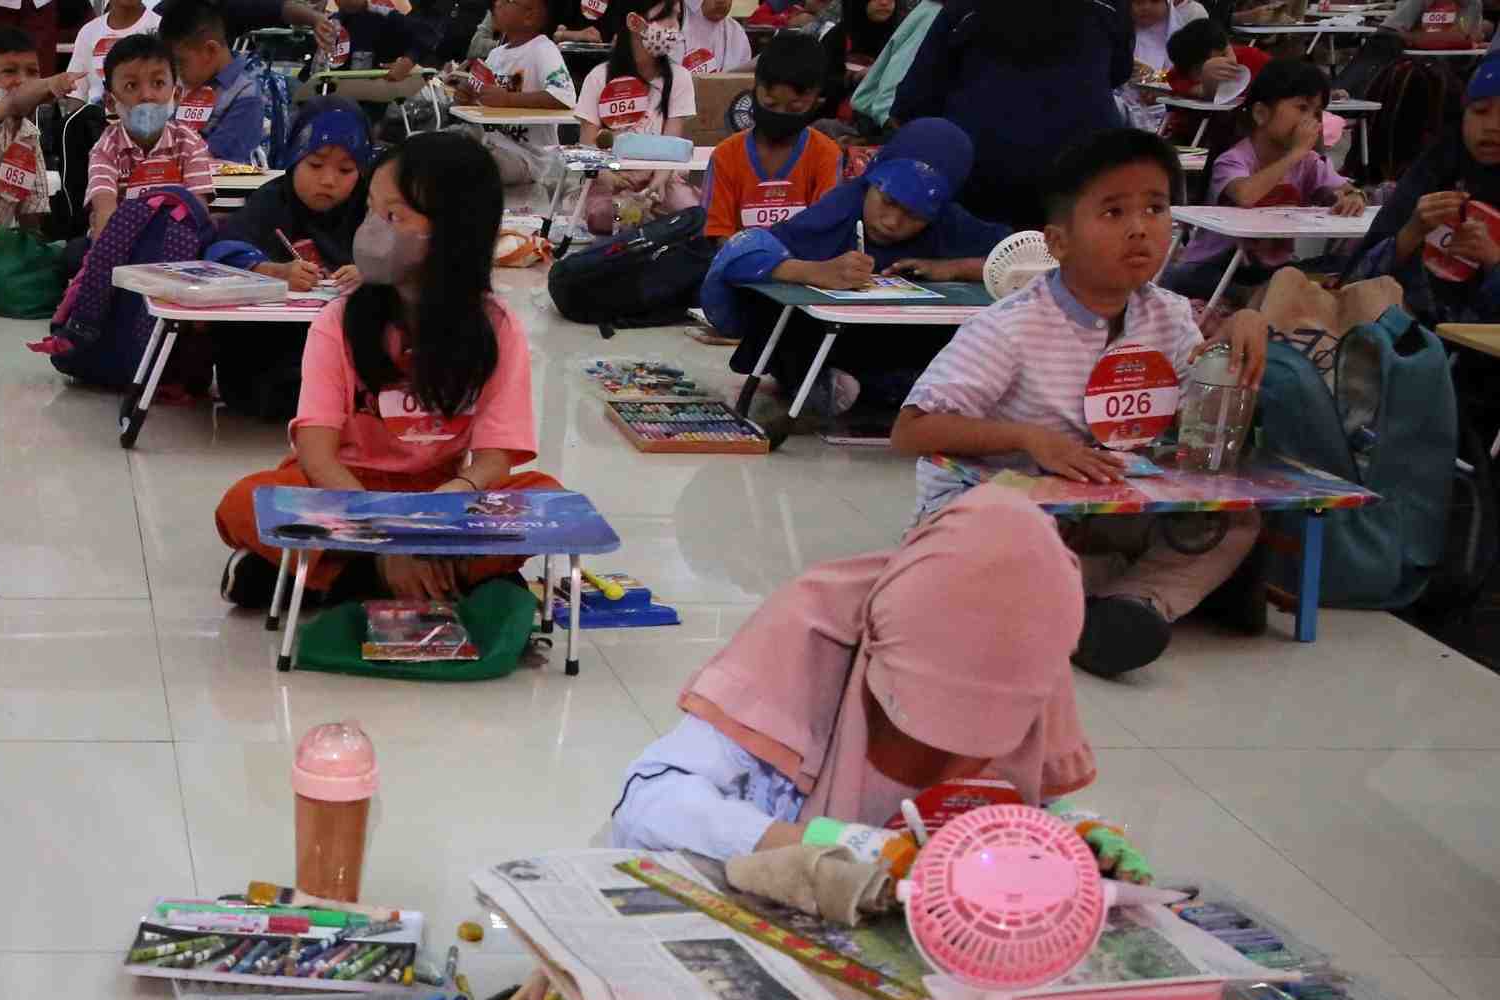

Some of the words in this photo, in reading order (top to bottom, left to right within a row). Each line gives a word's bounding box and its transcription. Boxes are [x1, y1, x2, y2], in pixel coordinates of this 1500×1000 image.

[610, 100, 636, 113] 064
[6, 168, 25, 184] 053
[757, 209, 790, 224] 052
[1106, 393, 1151, 417] 026
